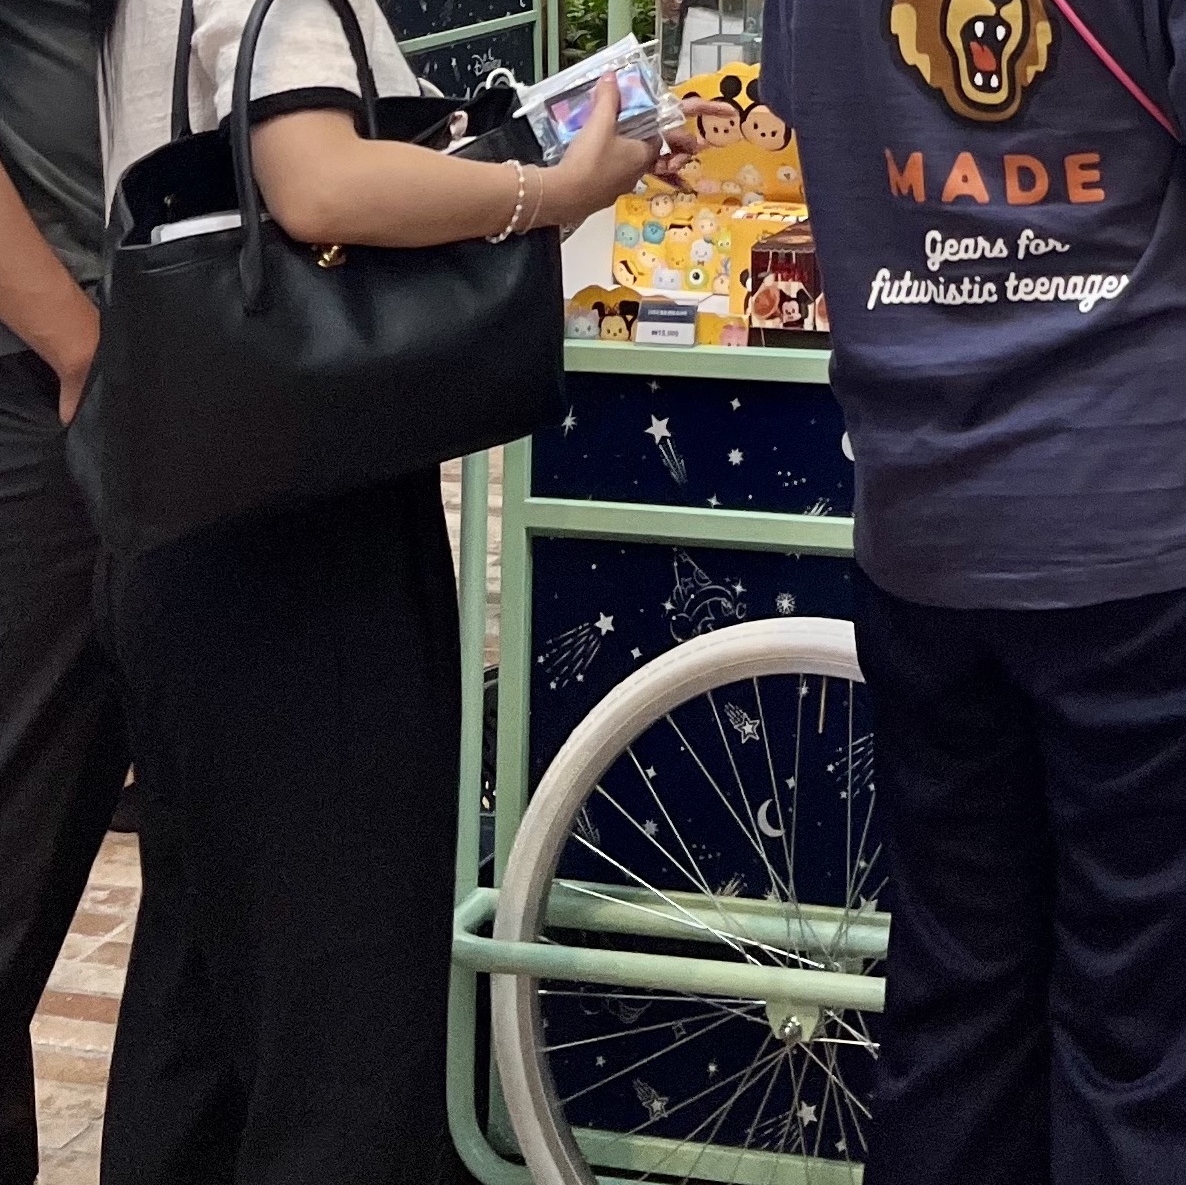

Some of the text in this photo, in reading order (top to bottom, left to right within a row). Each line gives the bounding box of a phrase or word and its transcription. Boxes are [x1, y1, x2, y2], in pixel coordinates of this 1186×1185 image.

[885, 148, 1105, 205] MADE
[925, 229, 1070, 272] Gears for
[867, 268, 998, 310] futuristic
